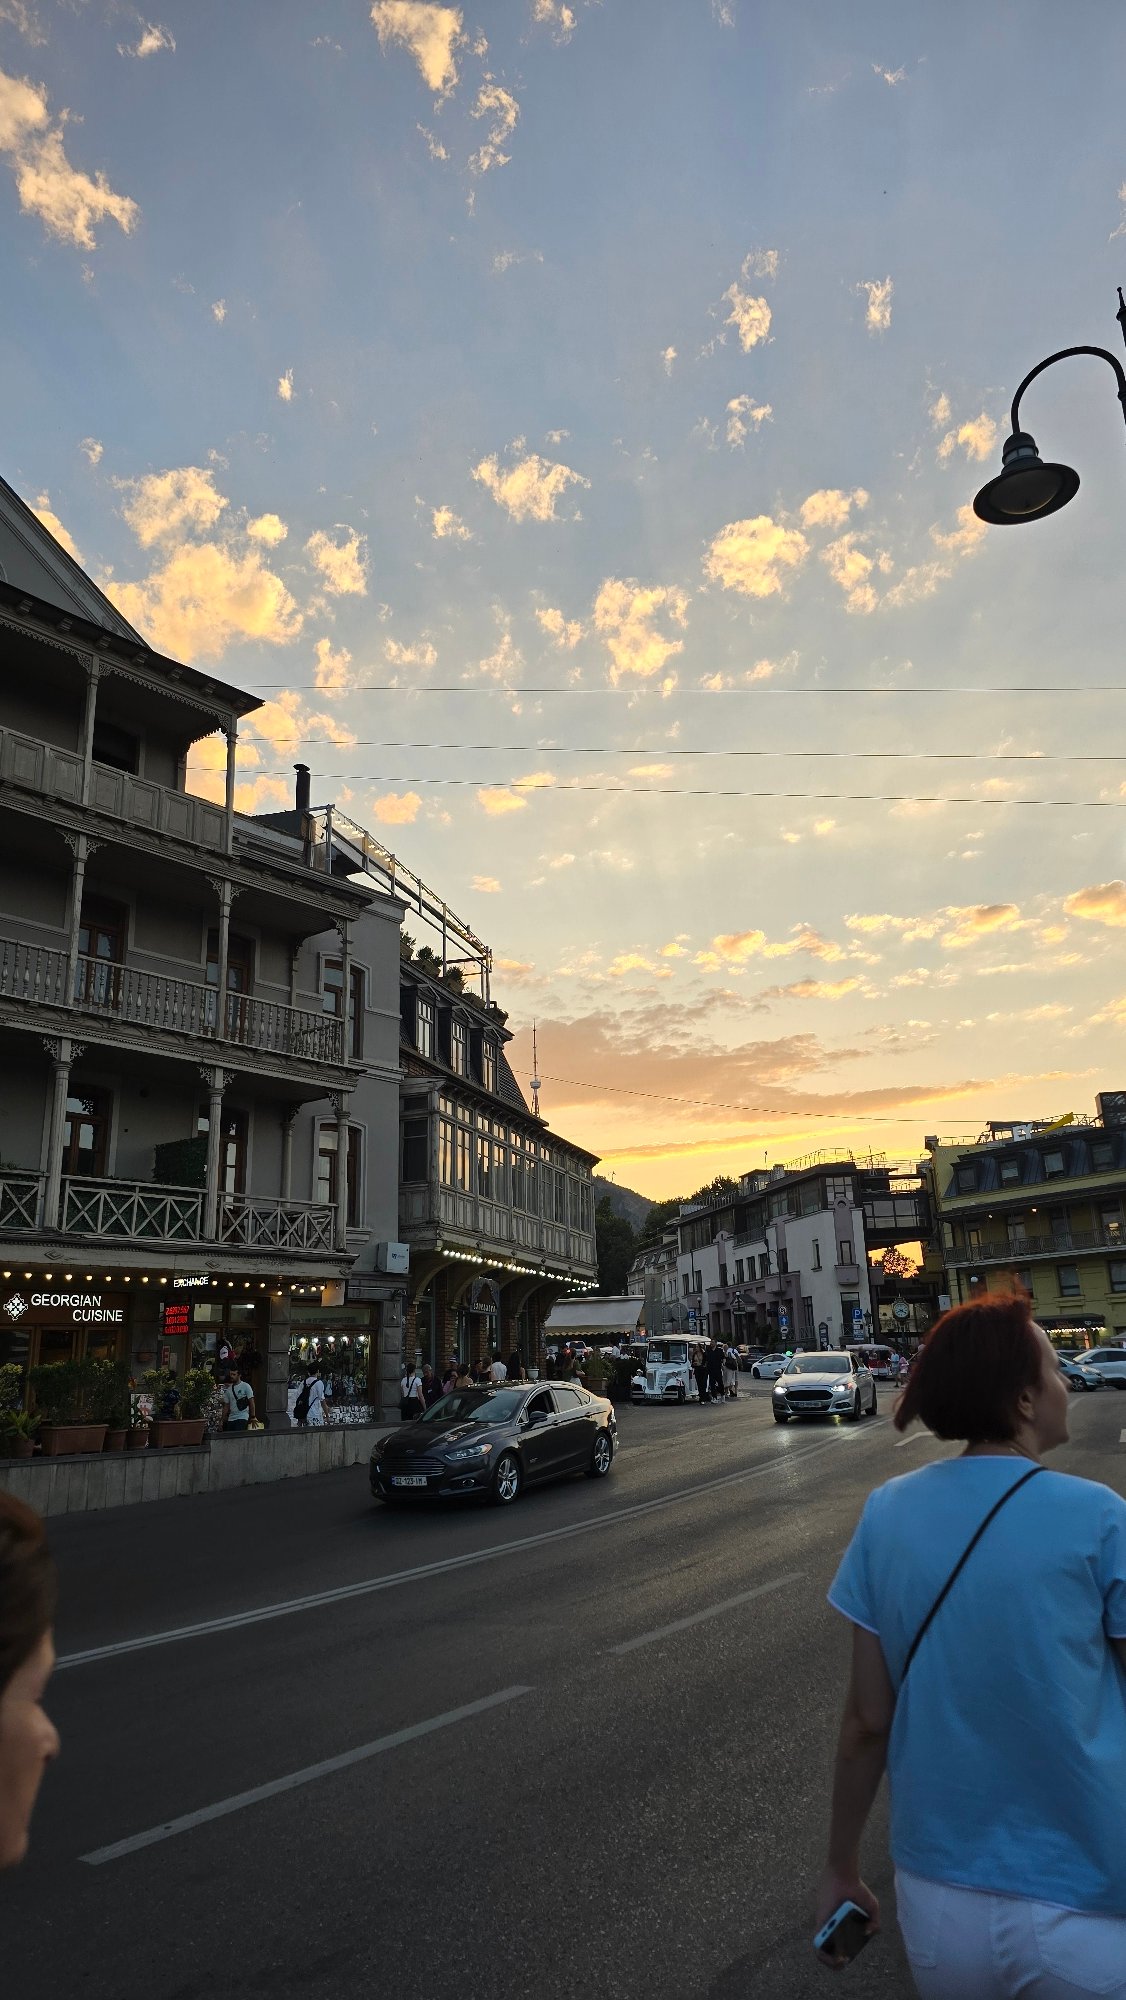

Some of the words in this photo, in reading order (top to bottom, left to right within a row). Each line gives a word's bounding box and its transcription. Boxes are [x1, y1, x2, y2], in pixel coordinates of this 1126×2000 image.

[173, 1276, 209, 1288] EXCHANGE
[31, 1294, 101, 1306] GEORGIAN
[72, 1310, 123, 1322] CUISINE
[854, 1309, 861, 1318] P
